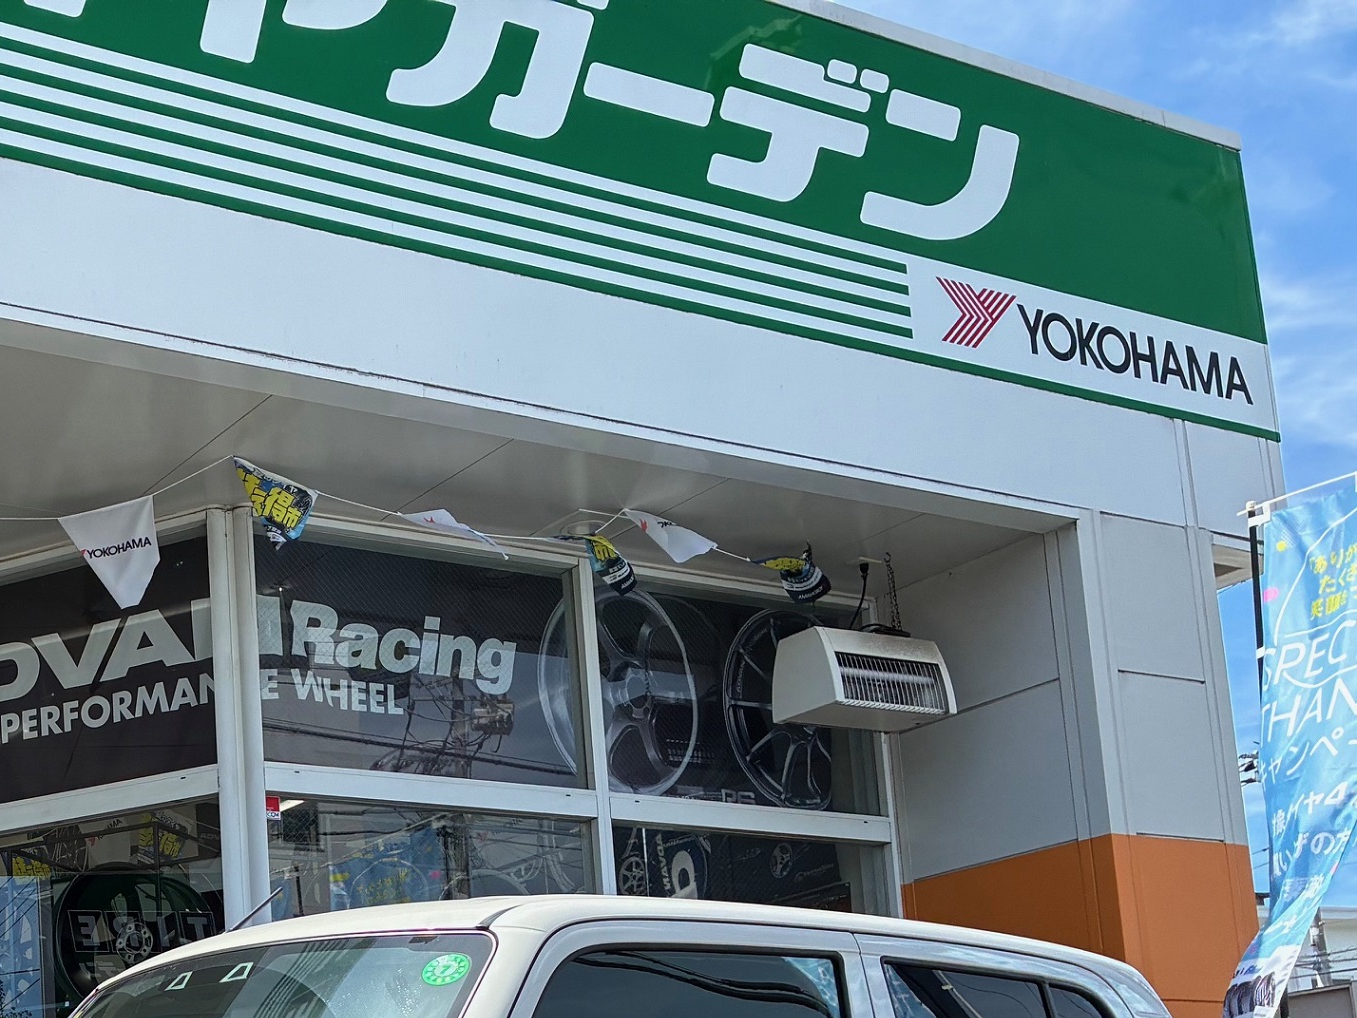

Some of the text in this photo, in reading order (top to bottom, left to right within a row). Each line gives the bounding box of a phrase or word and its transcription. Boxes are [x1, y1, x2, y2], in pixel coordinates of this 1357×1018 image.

[23, 0, 1021, 241] ガーデン
[1016, 303, 1254, 405] YOKOHAMA
[87, 537, 152, 559] YOKOHAMA
[291, 600, 517, 696] Racing
[0, 669, 405, 744] PERFORMANE WHEEL
